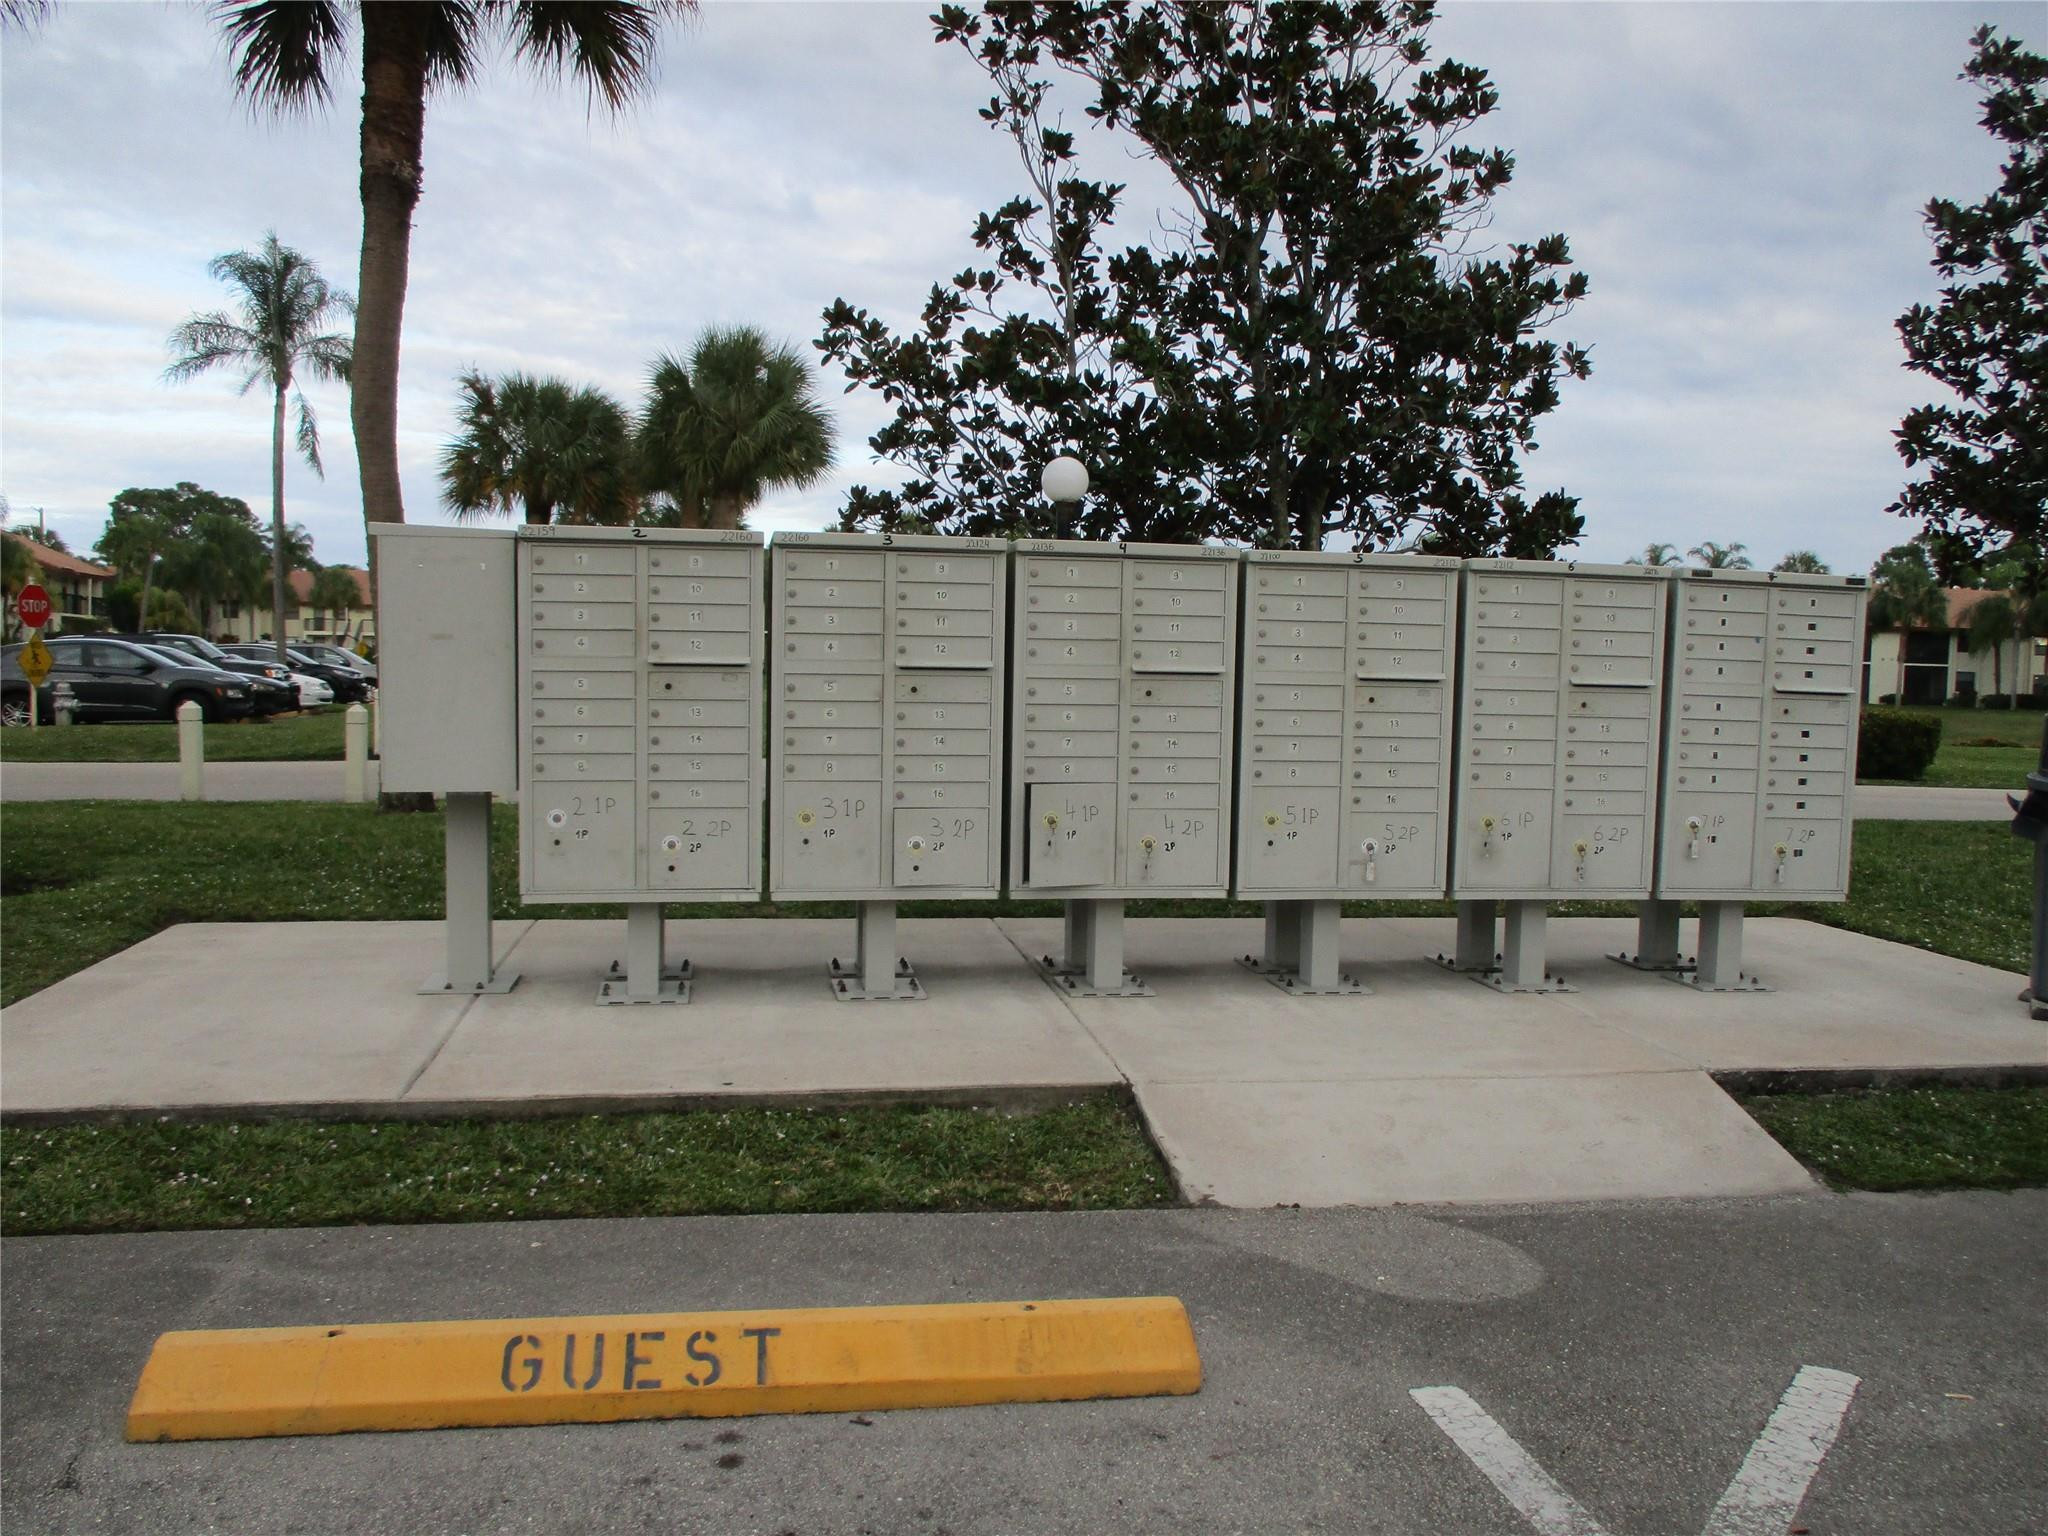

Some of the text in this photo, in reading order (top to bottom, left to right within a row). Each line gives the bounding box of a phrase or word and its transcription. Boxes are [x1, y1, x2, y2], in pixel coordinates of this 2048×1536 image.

[631, 528, 647, 538] 2
[882, 536, 893, 546] 3
[1119, 543, 1127, 553] 4
[1353, 554, 1364, 563] 5
[1567, 560, 1577, 571] 6
[691, 585, 702, 593] 10
[936, 591, 947, 600] 10
[21, 599, 48, 613] STOP
[1171, 598, 1181, 606] 10
[1394, 606, 1404, 614] 10
[691, 612, 701, 621] 11
[1606, 614, 1615, 622] 10
[936, 617, 946, 626] 11
[1170, 624, 1180, 632] 11
[1393, 632, 1402, 640] 11
[691, 640, 702, 649] 12
[1604, 639, 1614, 648] 11
[935, 645, 946, 653] 12
[1603, 663, 1612, 671] 12
[690, 708, 702, 717] 13
[935, 711, 945, 719] 13
[1390, 720, 1399, 728] 13
[690, 735, 702, 744] 14
[935, 737, 945, 746] 14
[1167, 740, 1178, 748] 14
[1389, 745, 1399, 753] 14
[1599, 749, 1609, 757] 14
[690, 762, 702, 770] 15
[934, 763, 944, 772] 15
[1166, 765, 1176, 773] 15
[1388, 769, 1397, 777] 15
[1598, 773, 1607, 781] 15
[933, 790, 944, 798] 16
[1166, 791, 1175, 799] 16
[1387, 795, 1396, 803] 16
[575, 830, 589, 839] 1P
[823, 829, 836, 839] 1P
[1066, 830, 1077, 839] 1P
[1286, 831, 1298, 840] 1P
[1501, 832, 1512, 840] 1P
[689, 843, 702, 852] 2P
[932, 842, 945, 851] 2P
[1165, 842, 1175, 852] 2P
[1384, 845, 1396, 854] 2P
[1594, 846, 1604, 855] 2P
[501, 1327, 781, 1392] GUEST
